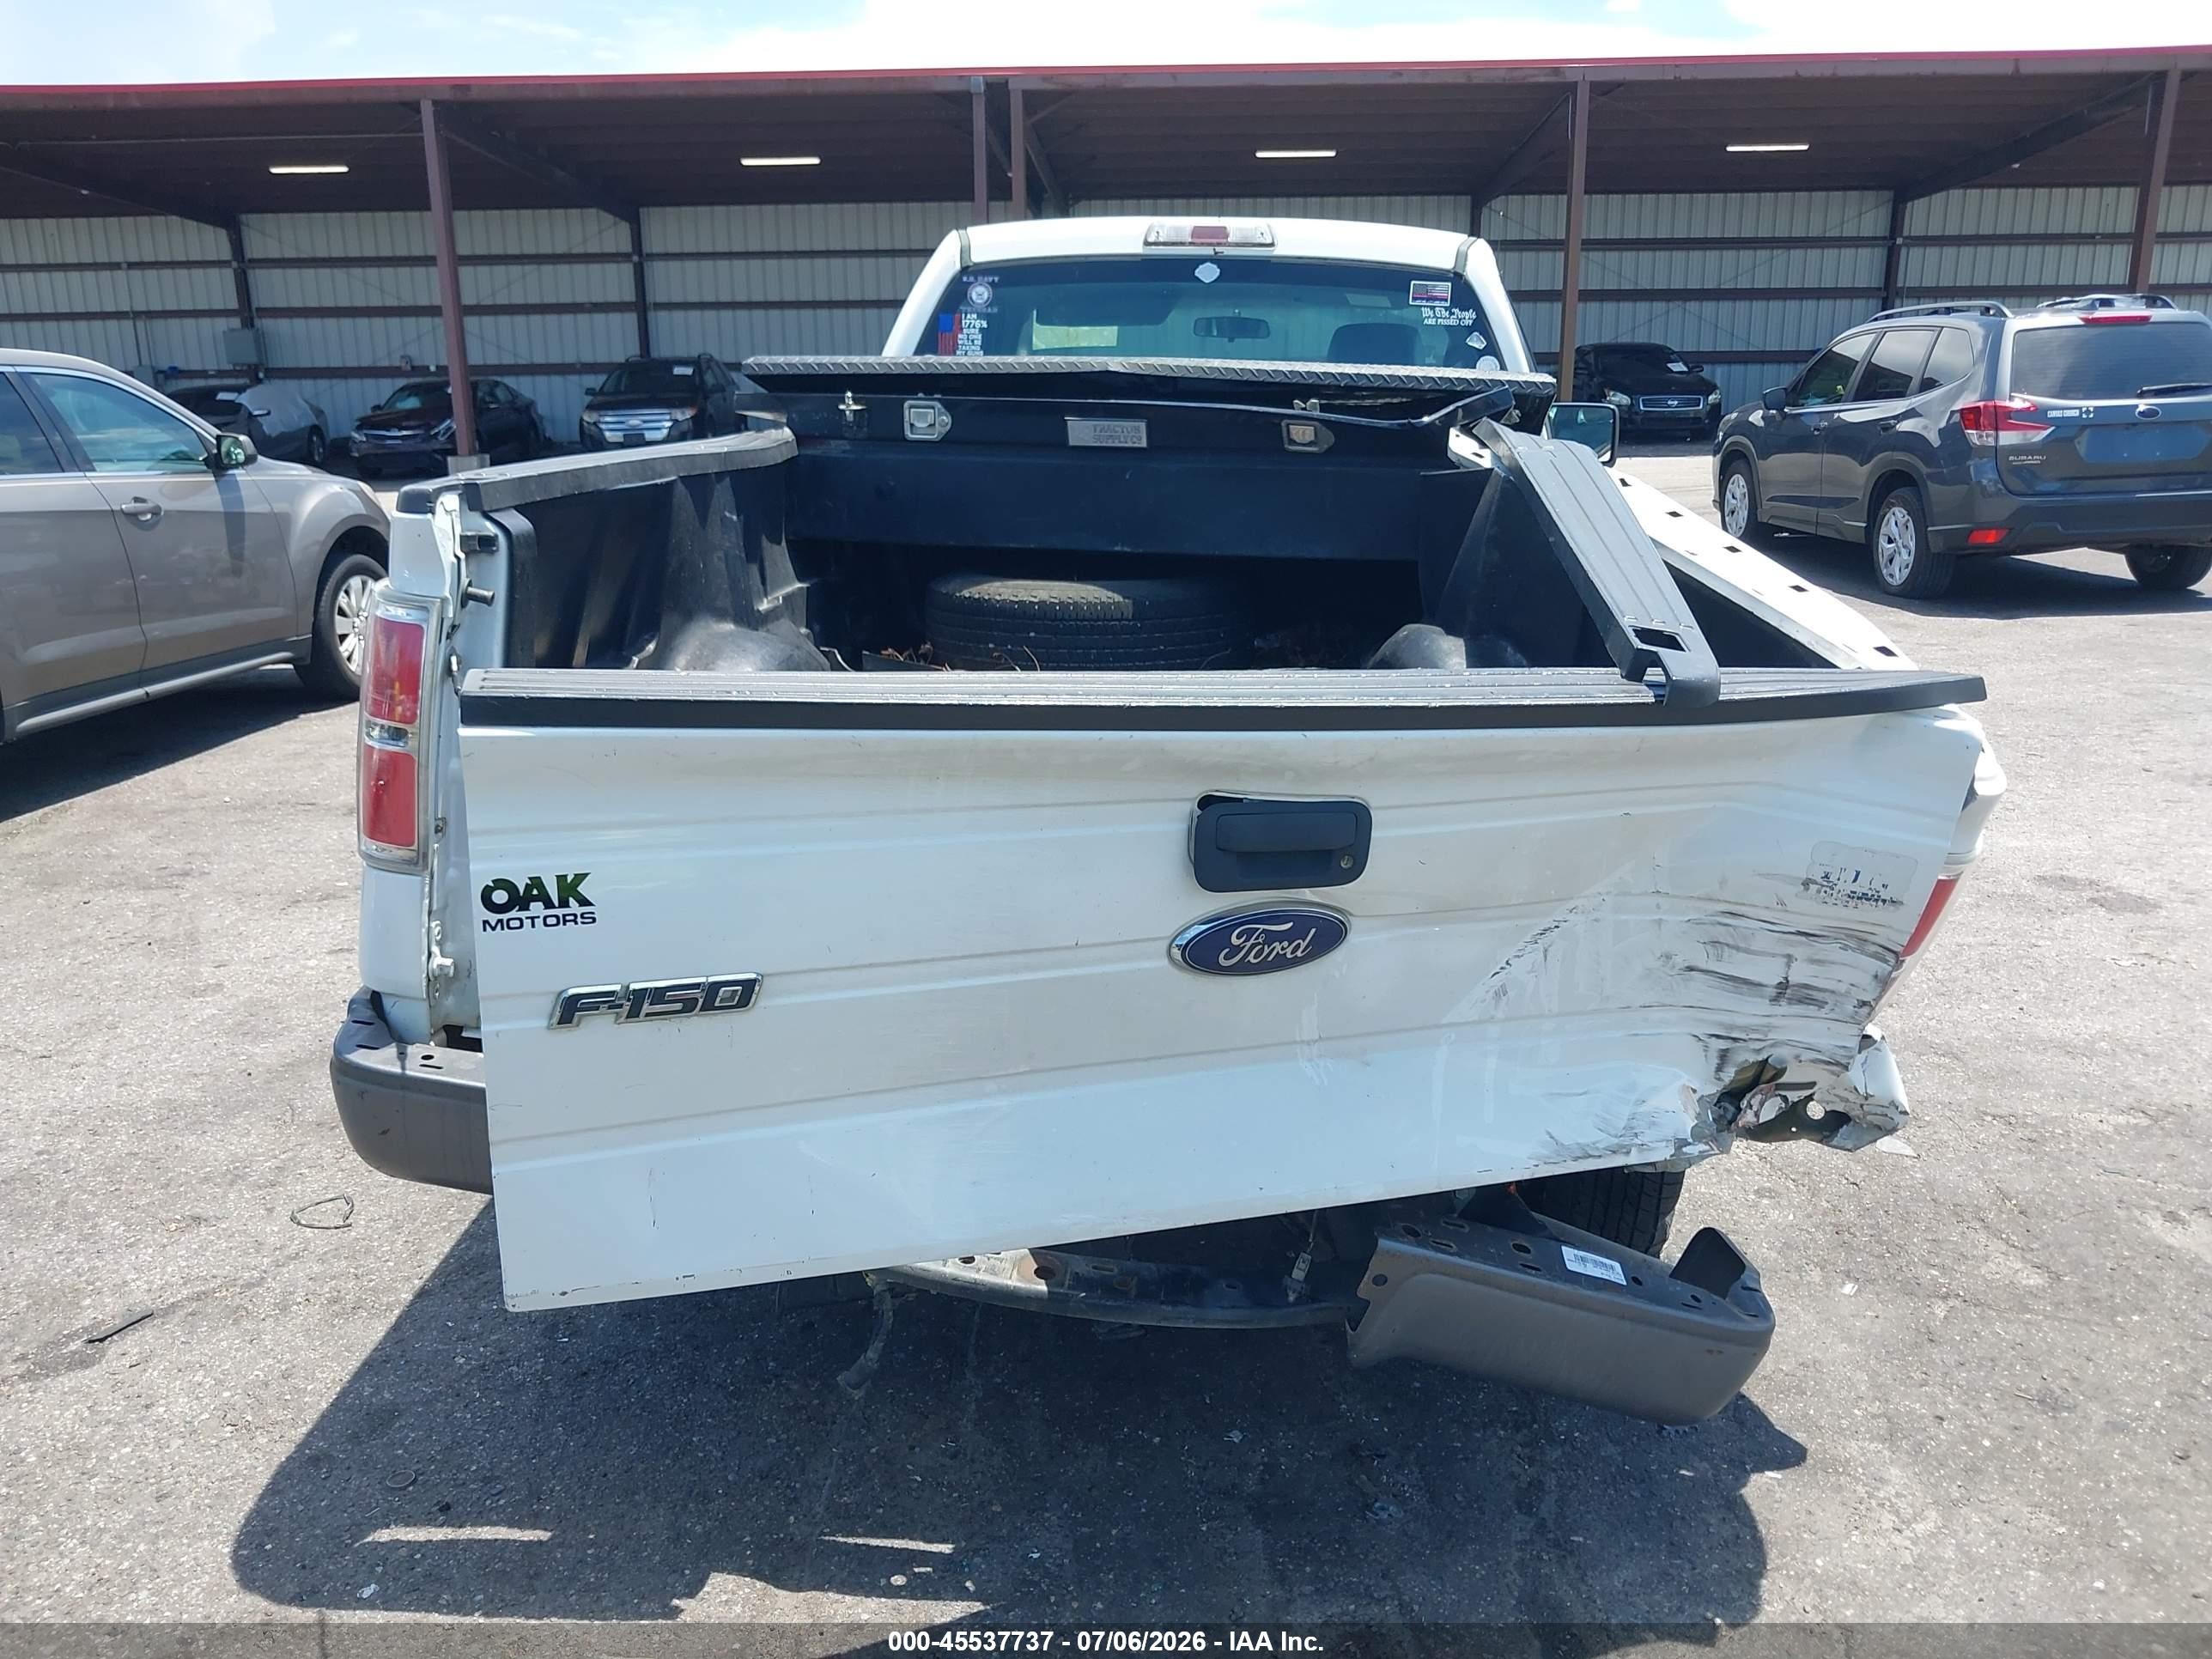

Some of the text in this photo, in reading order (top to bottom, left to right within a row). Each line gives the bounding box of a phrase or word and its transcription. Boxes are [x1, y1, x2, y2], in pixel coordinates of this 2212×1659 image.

[1421, 307, 1477, 319] We The People
[962, 320, 988, 329] 1776%
[1092, 425, 1141, 434] TRACTOR
[1092, 434, 1127, 444] SUPPLY
[480, 872, 597, 915] OAK
[482, 911, 597, 932] MOTORS
[1218, 921, 1316, 967] Ford
[548, 972, 763, 1030] F-150
